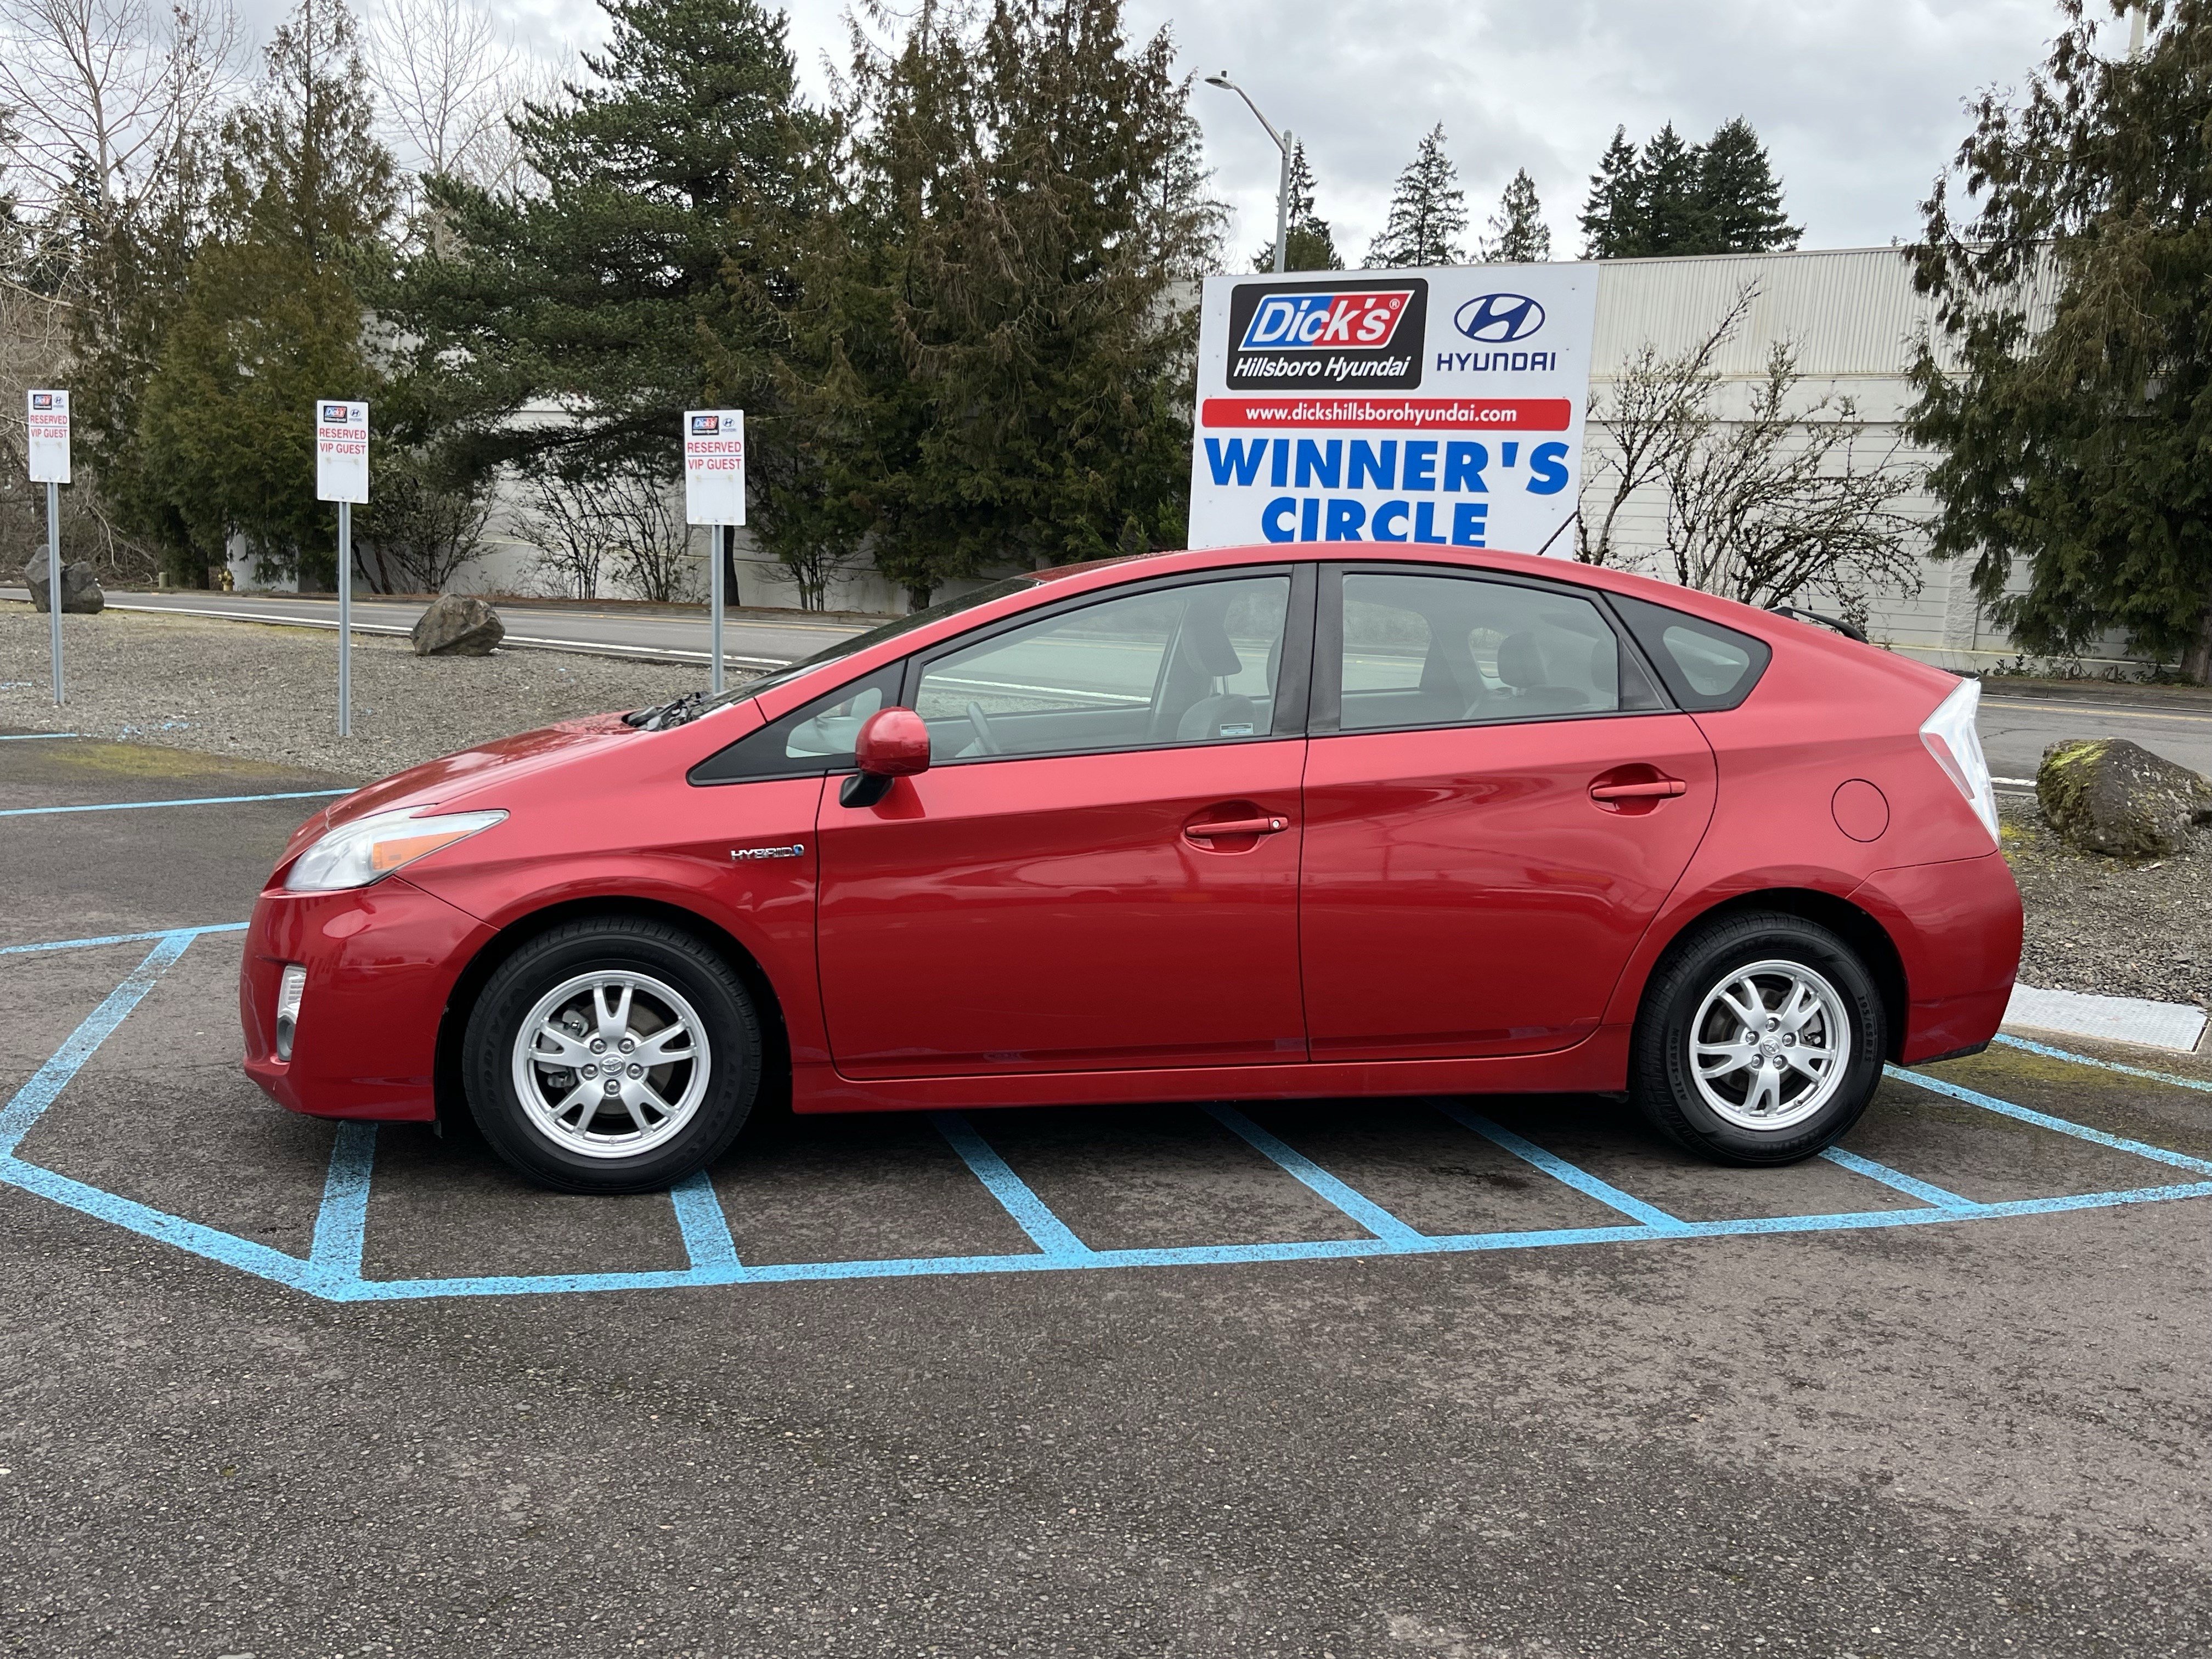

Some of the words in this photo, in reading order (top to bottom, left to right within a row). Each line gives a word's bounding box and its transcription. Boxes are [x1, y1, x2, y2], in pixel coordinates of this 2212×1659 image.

[1252, 298, 1392, 342] Dick's
[1437, 352, 1556, 371] HYUNDAI
[1233, 357, 1322, 379] Hillsboro
[1324, 356, 1412, 381] Hyundai
[30, 415, 67, 424] RESERVED
[1245, 402, 1517, 426] www.dickshillsborohyundai.com
[31, 428, 42, 437] VIP
[44, 428, 67, 438] GUEST
[319, 428, 366, 439] RESERVED
[320, 443, 333, 453] VIP
[336, 443, 366, 454] GUEST
[687, 442, 741, 453] RESERVED
[688, 459, 703, 470] VIP
[707, 459, 741, 470] GUEST
[1204, 438, 1570, 495] WINNER'S
[1261, 497, 1489, 548] CIRCLE
[731, 847, 794, 860] HYBRID
